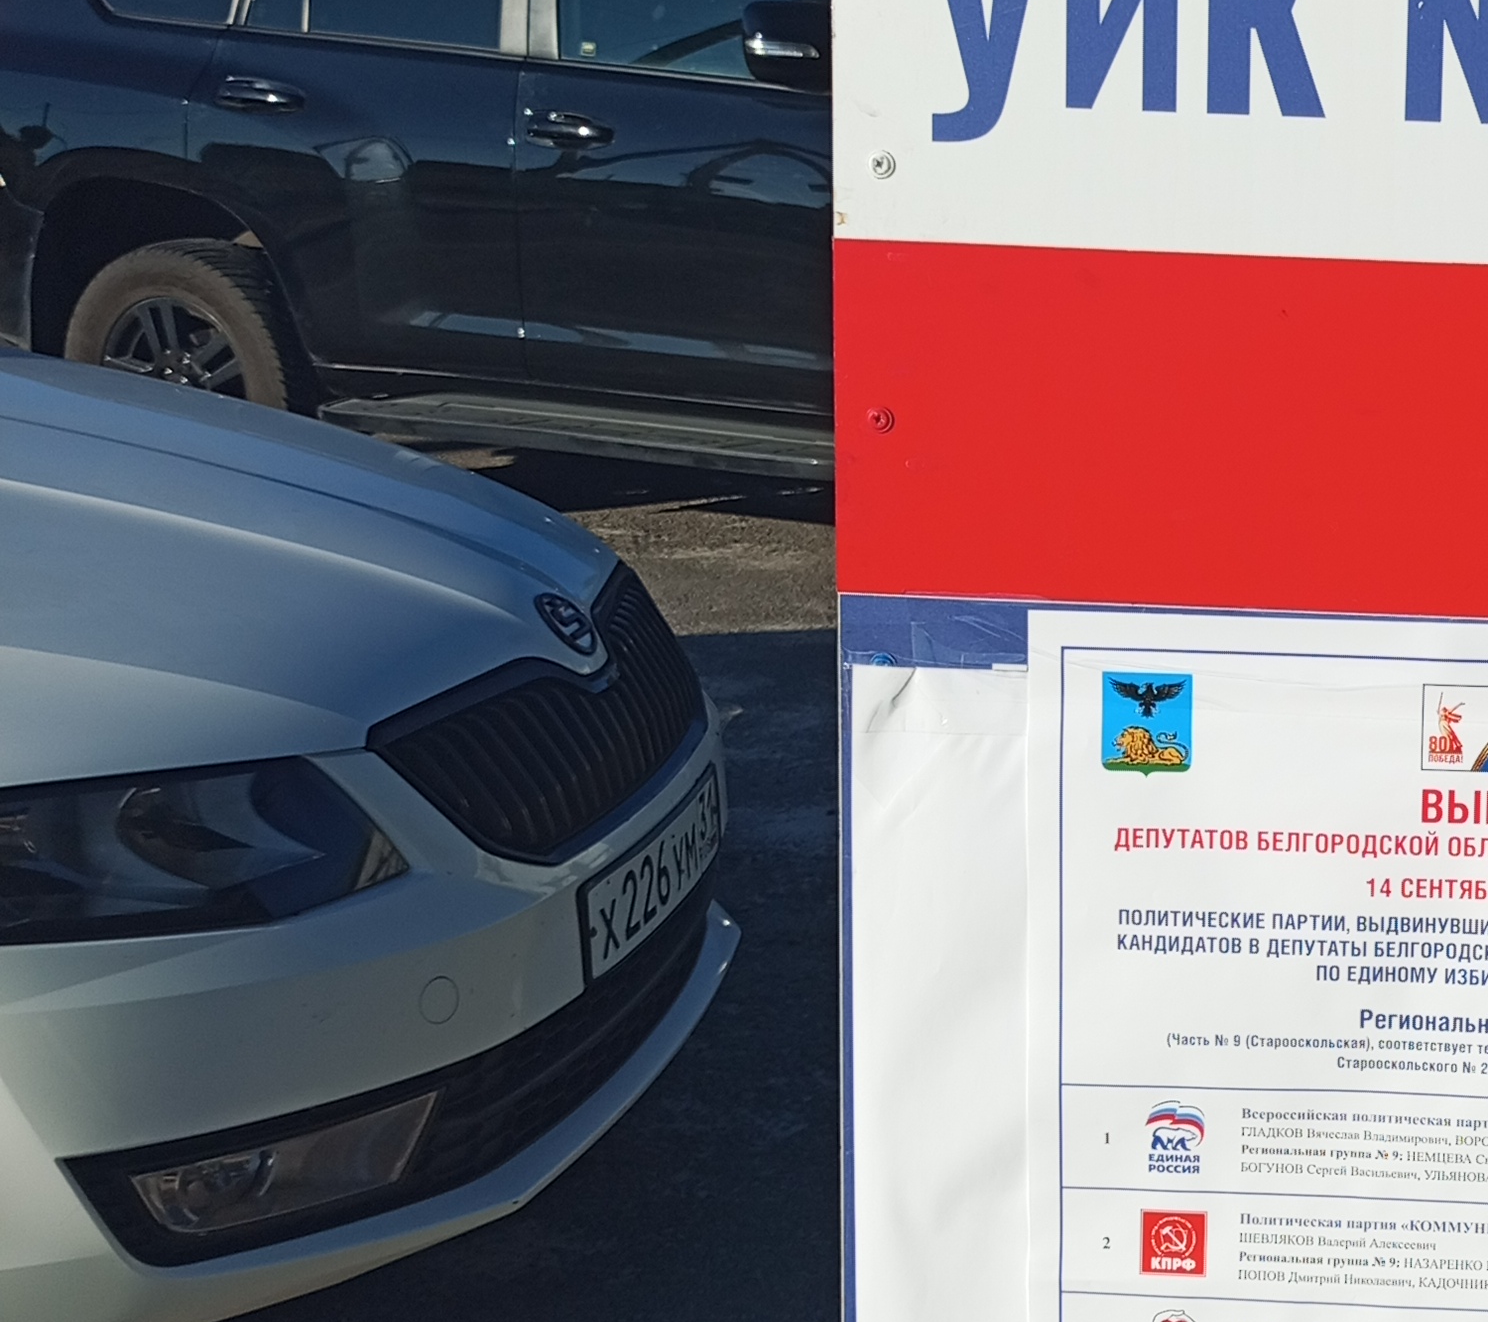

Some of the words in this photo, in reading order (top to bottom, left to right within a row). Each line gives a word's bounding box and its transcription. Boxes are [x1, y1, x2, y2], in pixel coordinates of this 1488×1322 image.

[1115, 828, 1248, 851] ДЕПУТАТОВ
[1258, 832, 1438, 857] БЕЛГОРОДСКОЙ
[1367, 878, 1391, 897] 14
[1119, 909, 1265, 929] ПОЛИТИЧЕСКИЕ
[1273, 914, 1350, 933] ПАРТИИ,
[1118, 934, 1241, 954] КАНДИДАТОВ
[1249, 938, 1259, 954] В
[1267, 939, 1366, 957] ДЕПУТАТЫ
[1317, 965, 1340, 981] ПО
[1348, 966, 1437, 984] ЕДИНОМУ
[1167, 1033, 1210, 1047] (Часть
[1215, 1034, 1228, 1046] №
[1234, 1035, 1240, 1046] 9
[1246, 1035, 1374, 1051] (Старооскольская),
[1378, 1040, 1472, 1055] соответствует
[1337, 1057, 1457, 1072] Старооскольского
[1463, 1061, 1476, 1073] №
[1242, 1108, 1347, 1121] Всероссийская
[1353, 1114, 1451, 1126] политическая
[1104, 1133, 1110, 1145] 1
[1148, 1154, 1200, 1164] ЕДИНАЯ
[1148, 1164, 1200, 1174] РОССИЯ
[1241, 1214, 1341, 1228] Политическая
[1347, 1221, 1396, 1232] партия
[1102, 1237, 1111, 1249] 2
[1151, 1257, 1196, 1272] КПРФ
